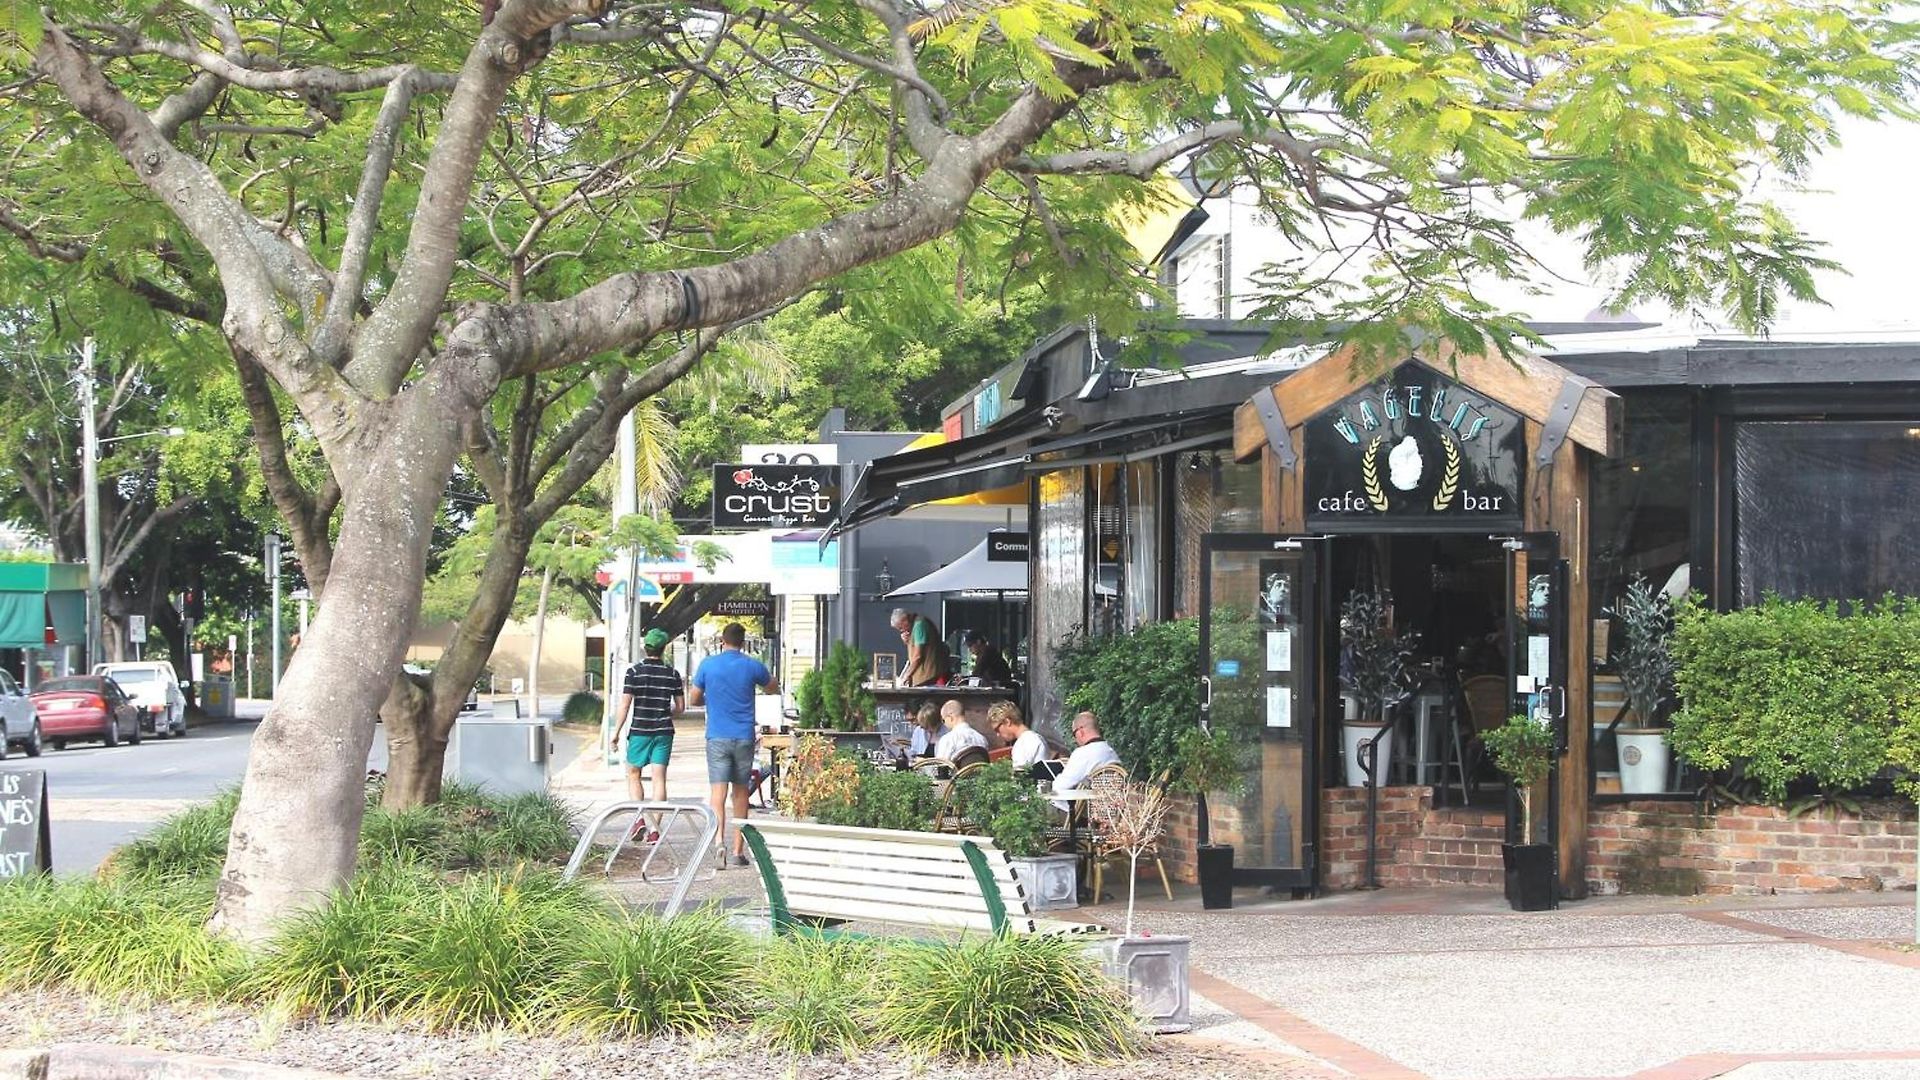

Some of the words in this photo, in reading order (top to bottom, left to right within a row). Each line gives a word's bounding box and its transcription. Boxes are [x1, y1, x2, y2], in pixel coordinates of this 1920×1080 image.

[725, 492, 831, 514] crust
[1318, 490, 1366, 512] cafe
[1462, 489, 1503, 512] bar
[718, 602, 769, 612] HAMILTON
